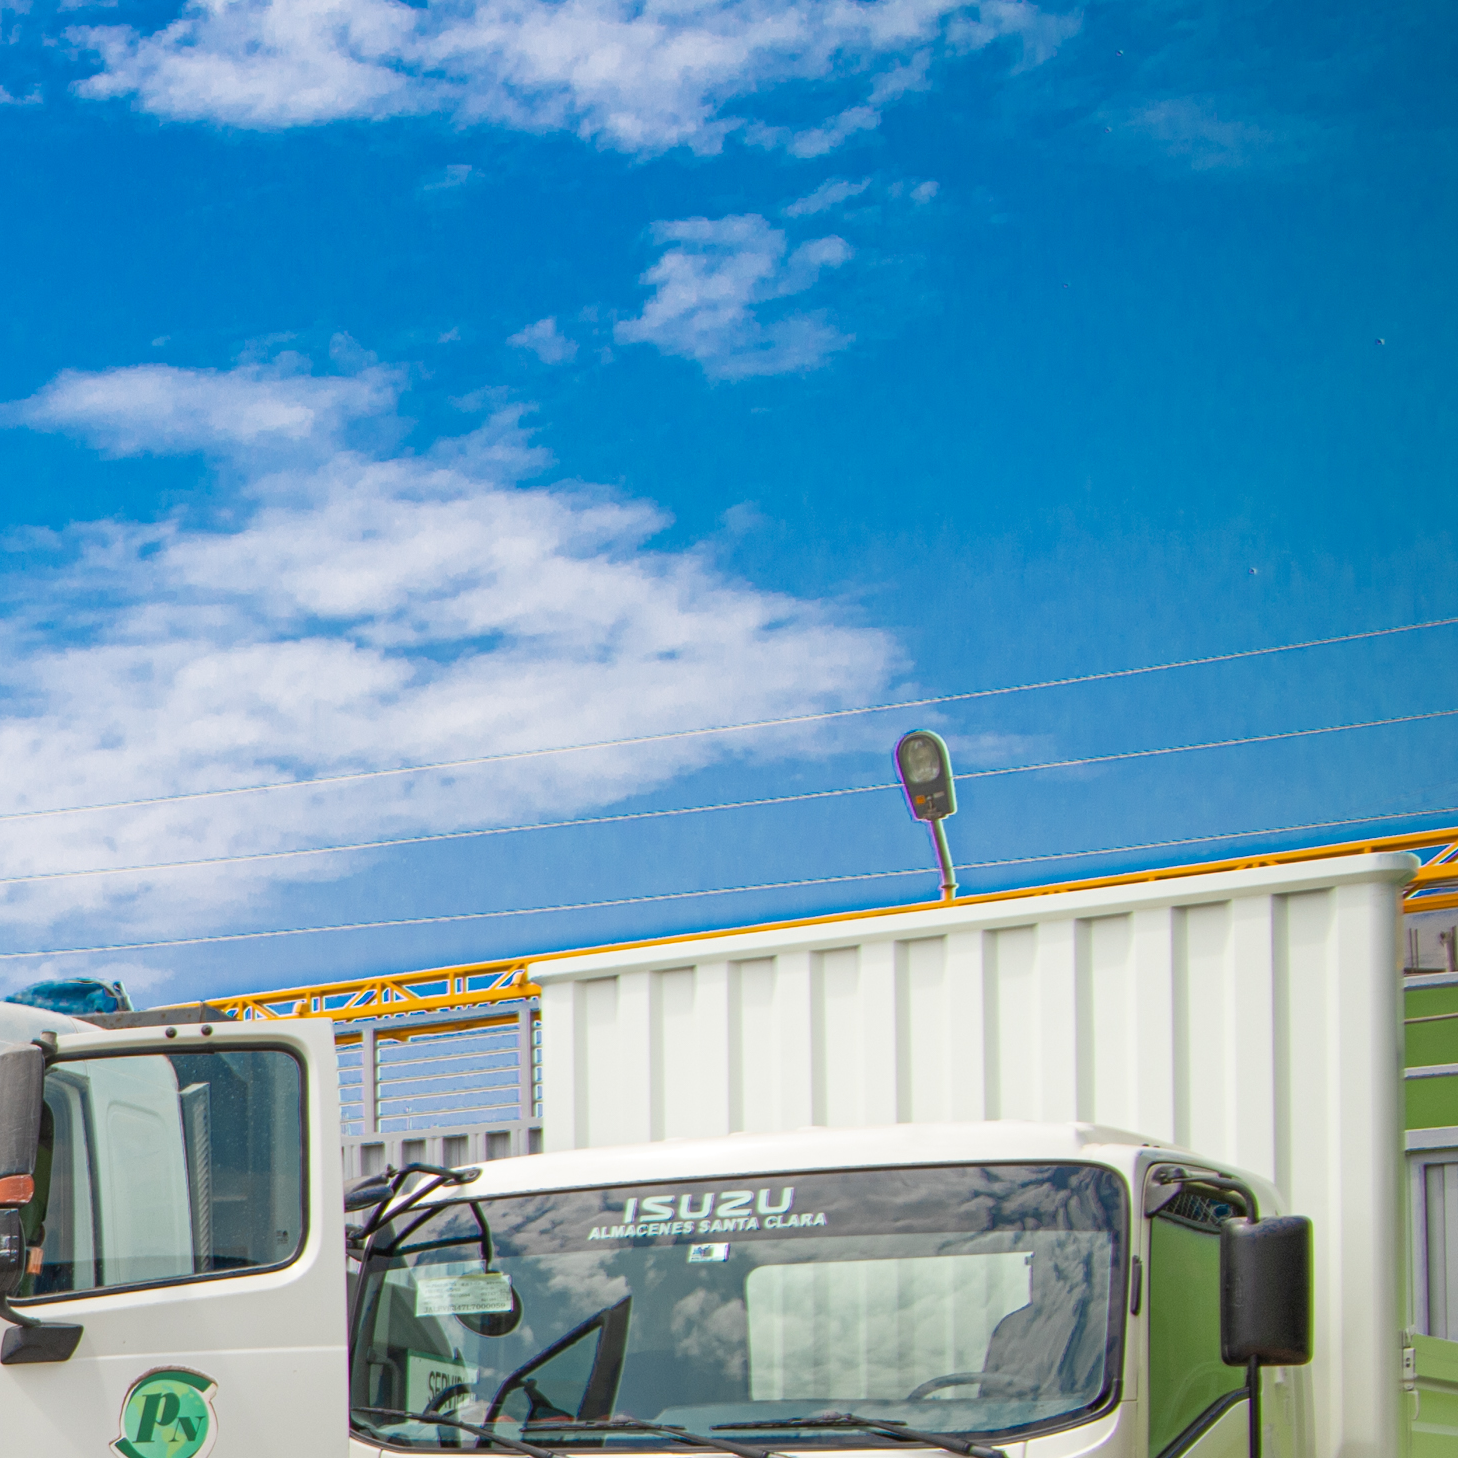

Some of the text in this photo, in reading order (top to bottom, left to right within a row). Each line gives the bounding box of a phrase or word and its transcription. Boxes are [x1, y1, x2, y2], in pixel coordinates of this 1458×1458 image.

[623, 1187, 795, 1224] ISUZU
[587, 1212, 828, 1241] ALMACENES SANTA CLARA
